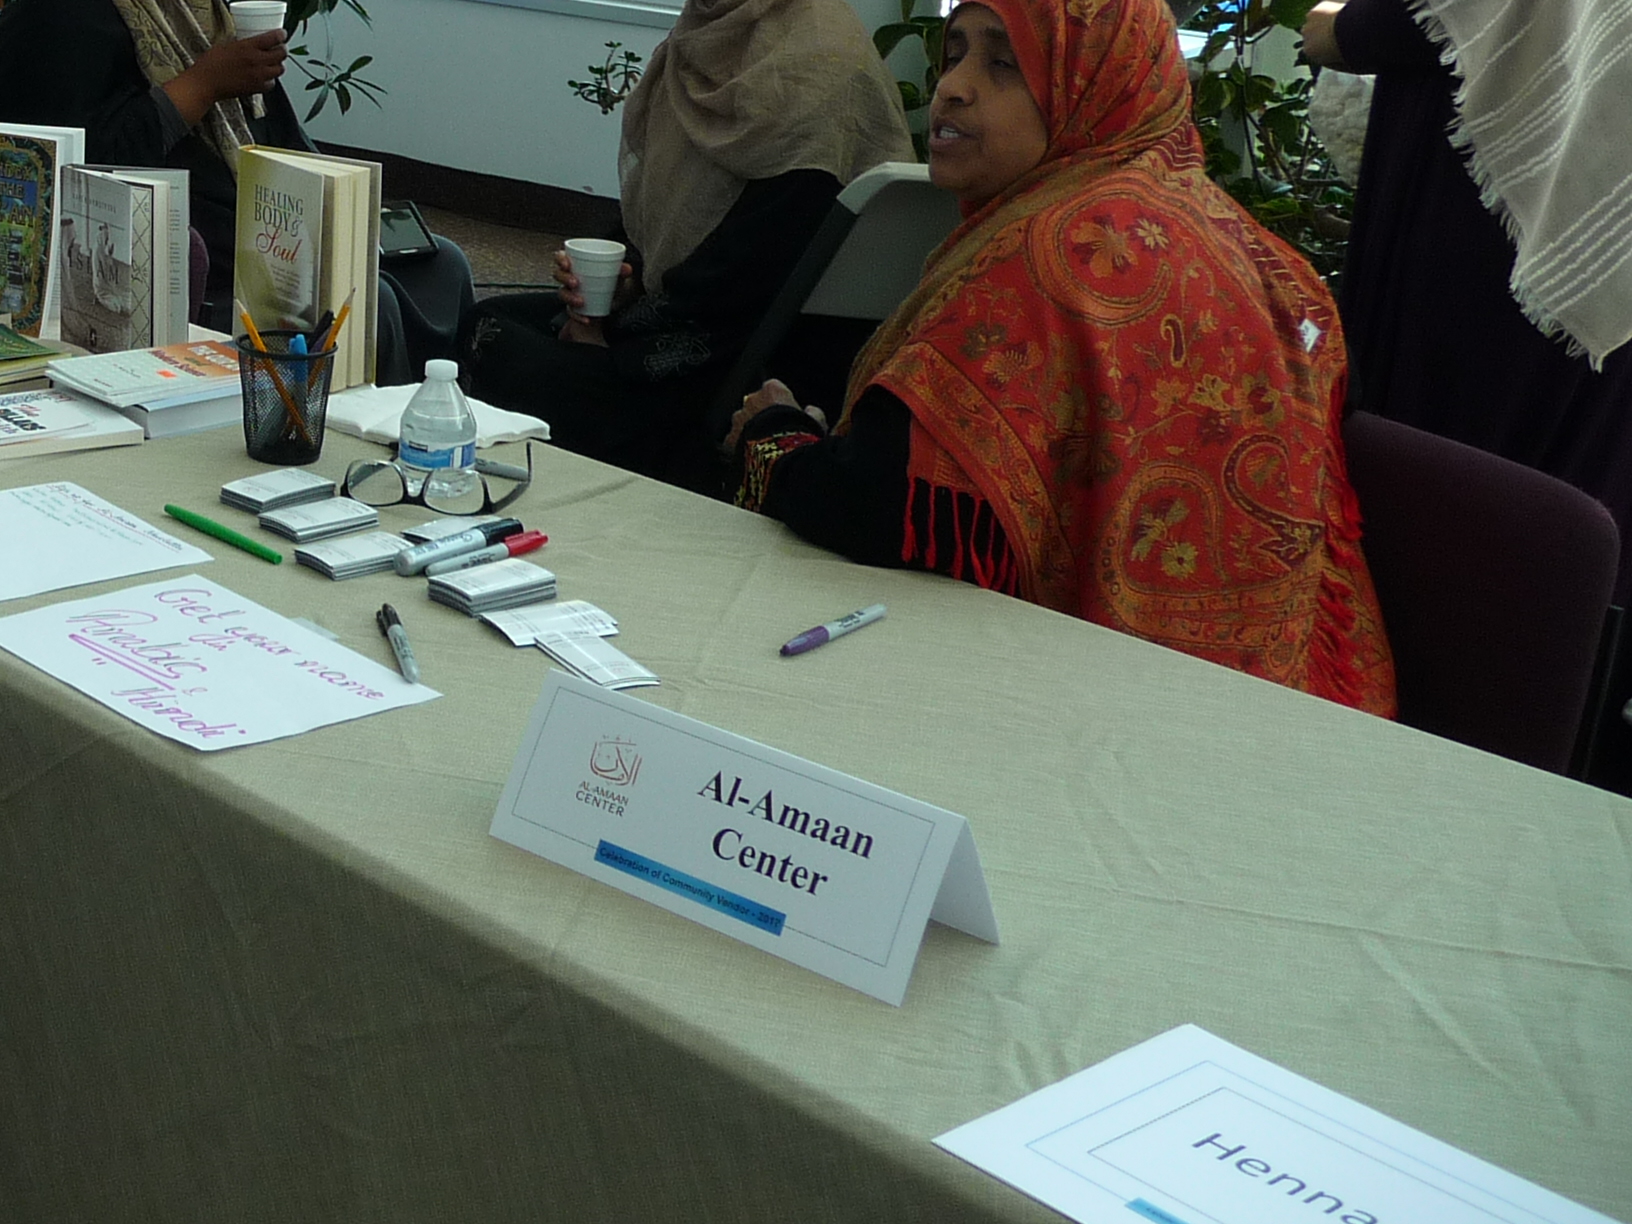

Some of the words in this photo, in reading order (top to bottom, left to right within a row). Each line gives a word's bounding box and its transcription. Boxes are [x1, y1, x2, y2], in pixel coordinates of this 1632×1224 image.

[254, 184, 304, 216] HEALING
[254, 201, 291, 232] BODY
[255, 224, 303, 265] Soul
[66, 608, 208, 675] Arabic
[154, 588, 246, 624] Get
[224, 626, 301, 657] your
[294, 658, 386, 700] name
[575, 790, 625, 817] CENTER
[578, 780, 629, 806] AL-AMAAN
[696, 770, 874, 859] Al-Amaan
[598, 847, 650, 874] Celebration
[651, 868, 662, 880] of
[662, 873, 715, 901] Community
[717, 894, 750, 916] Vendor
[757, 913, 782, 927] 2017
[712, 827, 829, 896] Center
[1191, 1132, 1378, 1224] Henna
